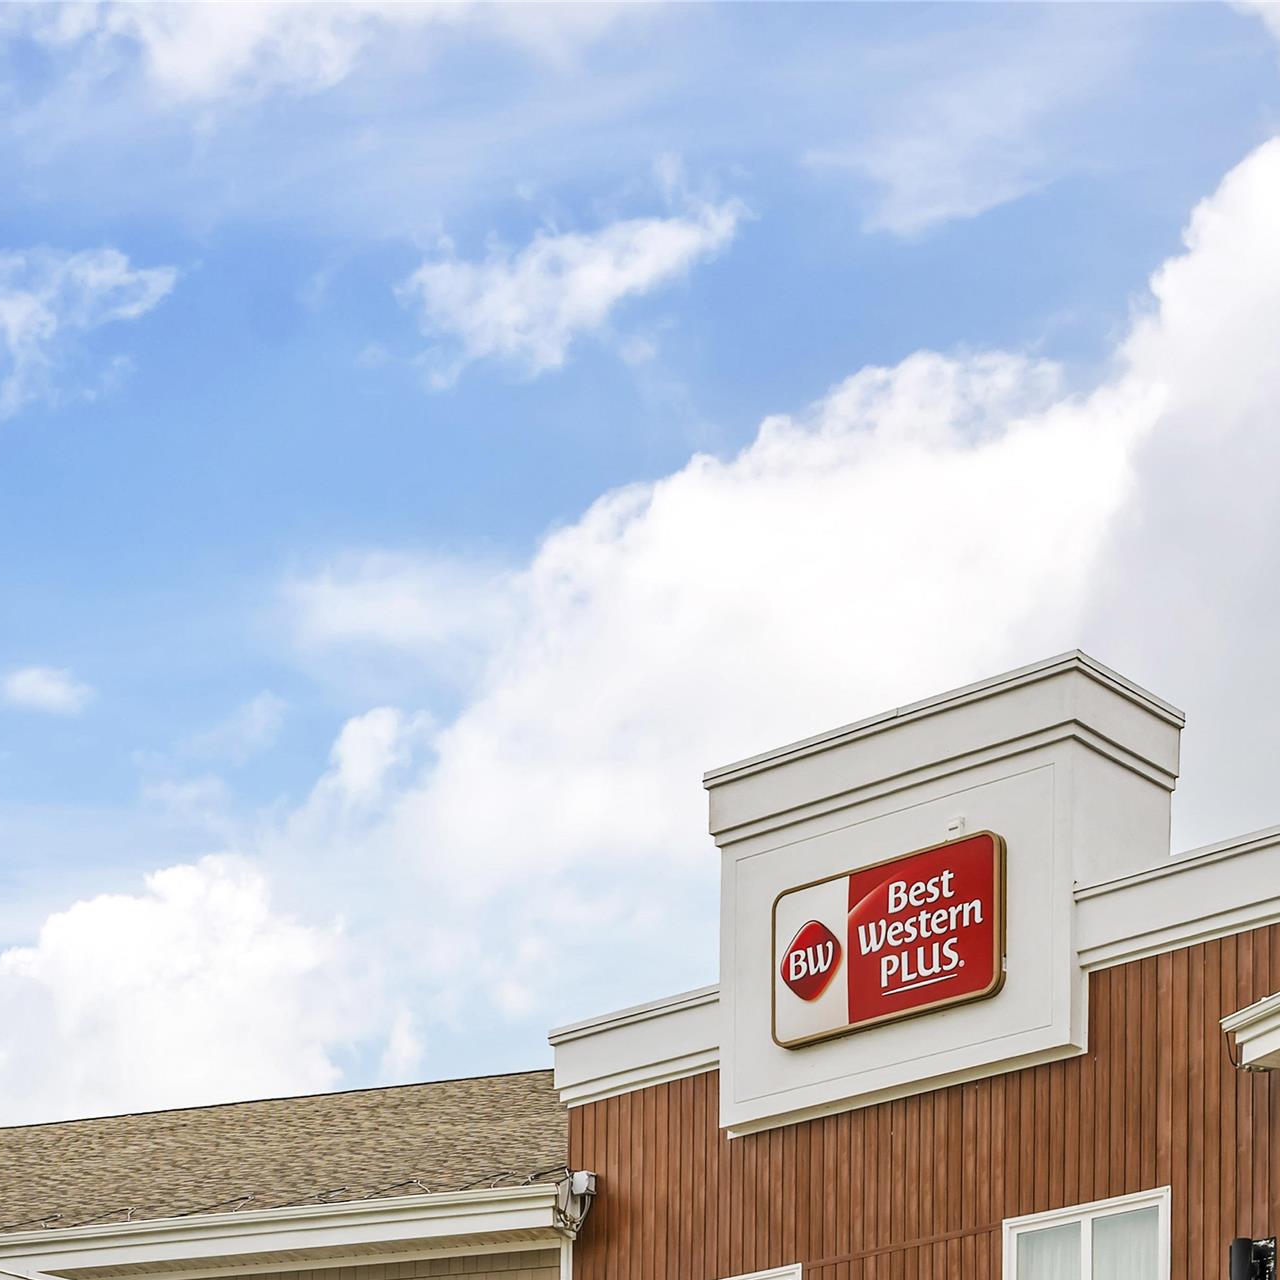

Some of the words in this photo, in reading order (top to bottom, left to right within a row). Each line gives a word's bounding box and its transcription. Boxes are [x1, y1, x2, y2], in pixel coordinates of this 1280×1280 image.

[887, 869, 955, 914] Best
[857, 898, 984, 956] Western
[788, 940, 834, 982] BW
